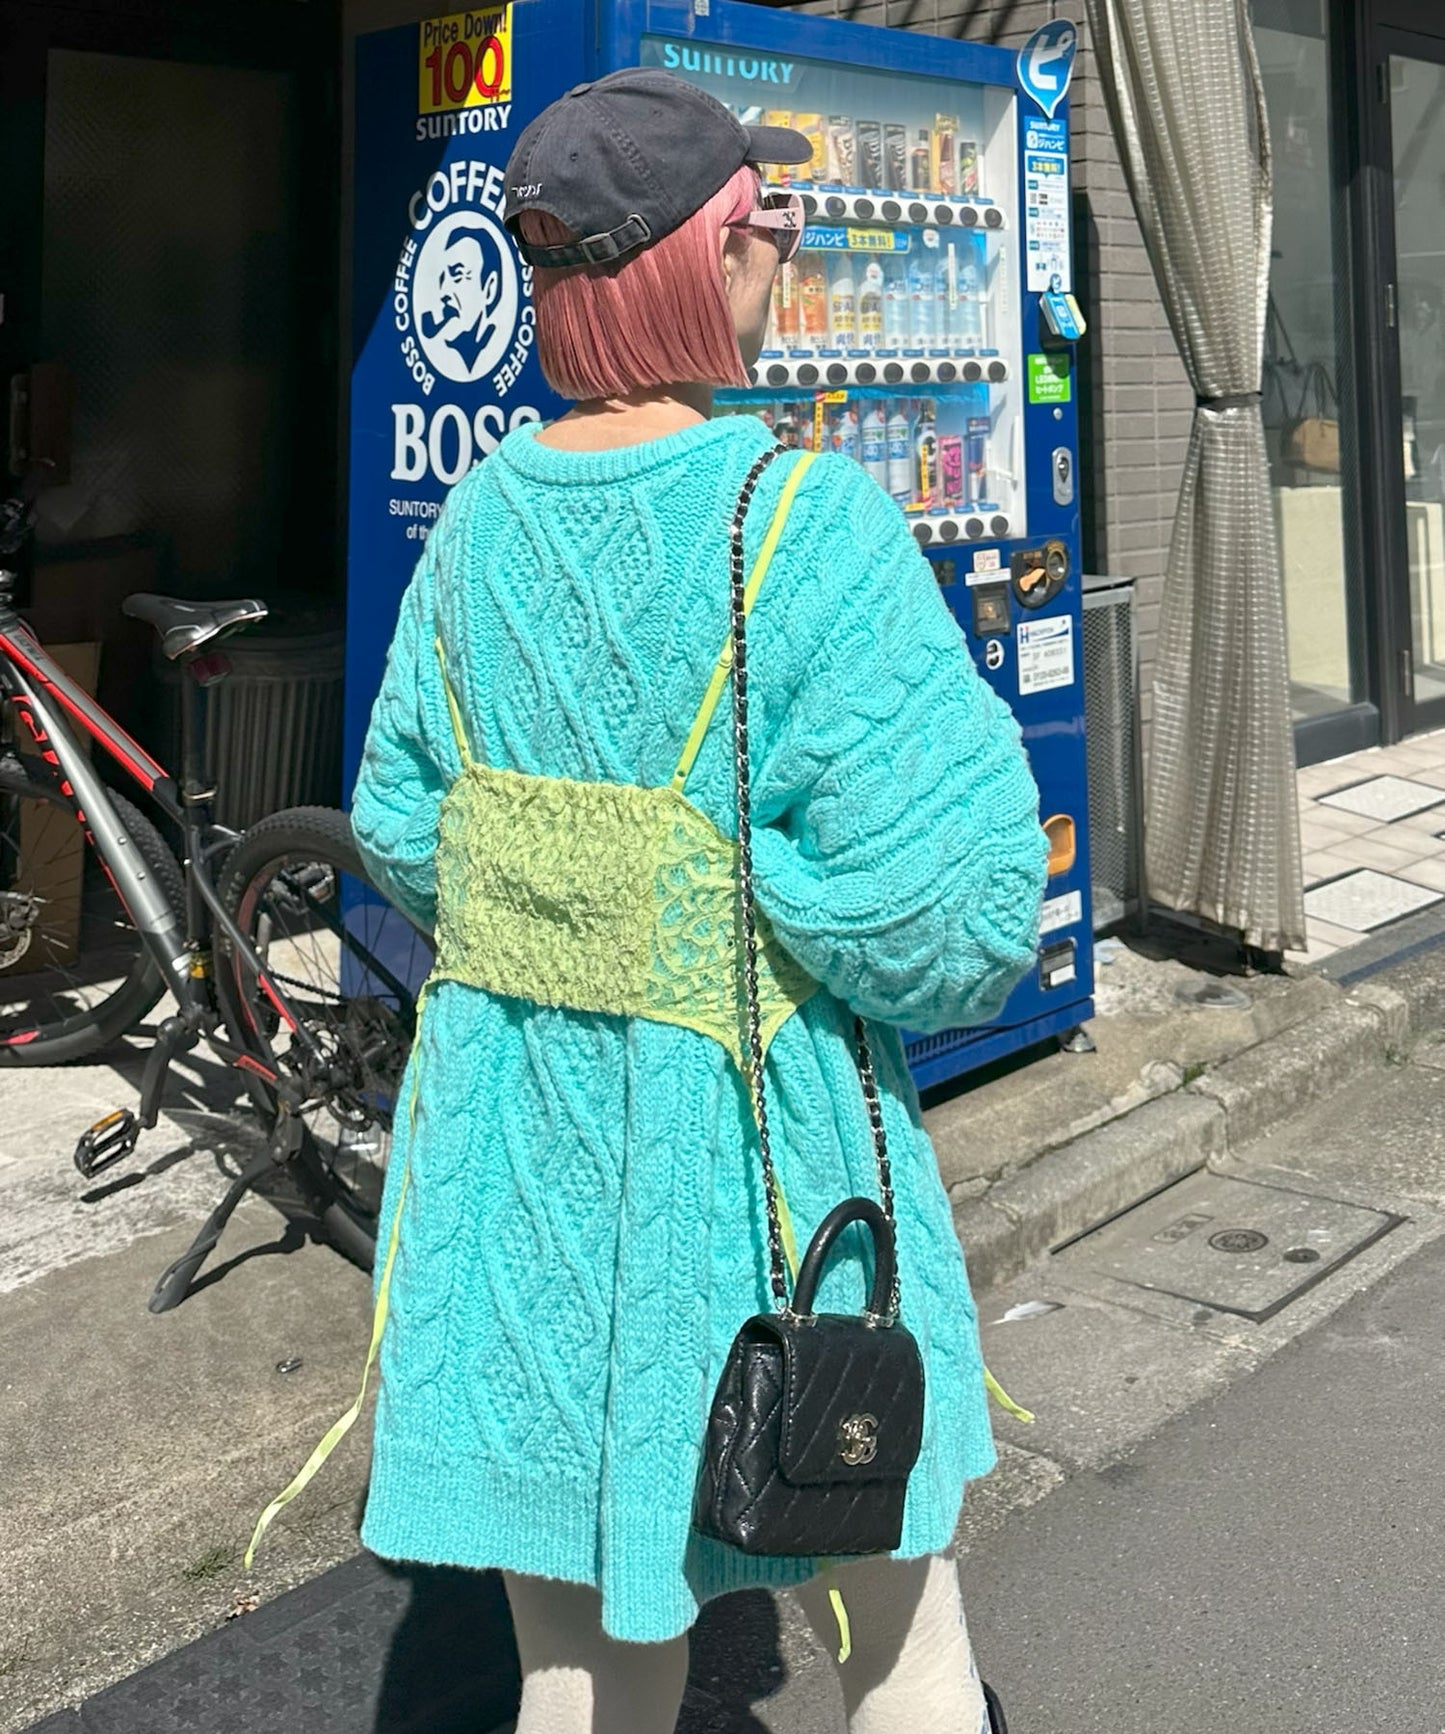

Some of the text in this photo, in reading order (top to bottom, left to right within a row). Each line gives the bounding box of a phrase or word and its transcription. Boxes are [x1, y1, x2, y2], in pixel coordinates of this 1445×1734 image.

[424, 12, 507, 48] Price Down!
[425, 35, 505, 107] 100
[416, 104, 512, 141] SUNTORY
[394, 235, 436, 396] BOSS COFFEE
[492, 305, 537, 397] COFFEE
